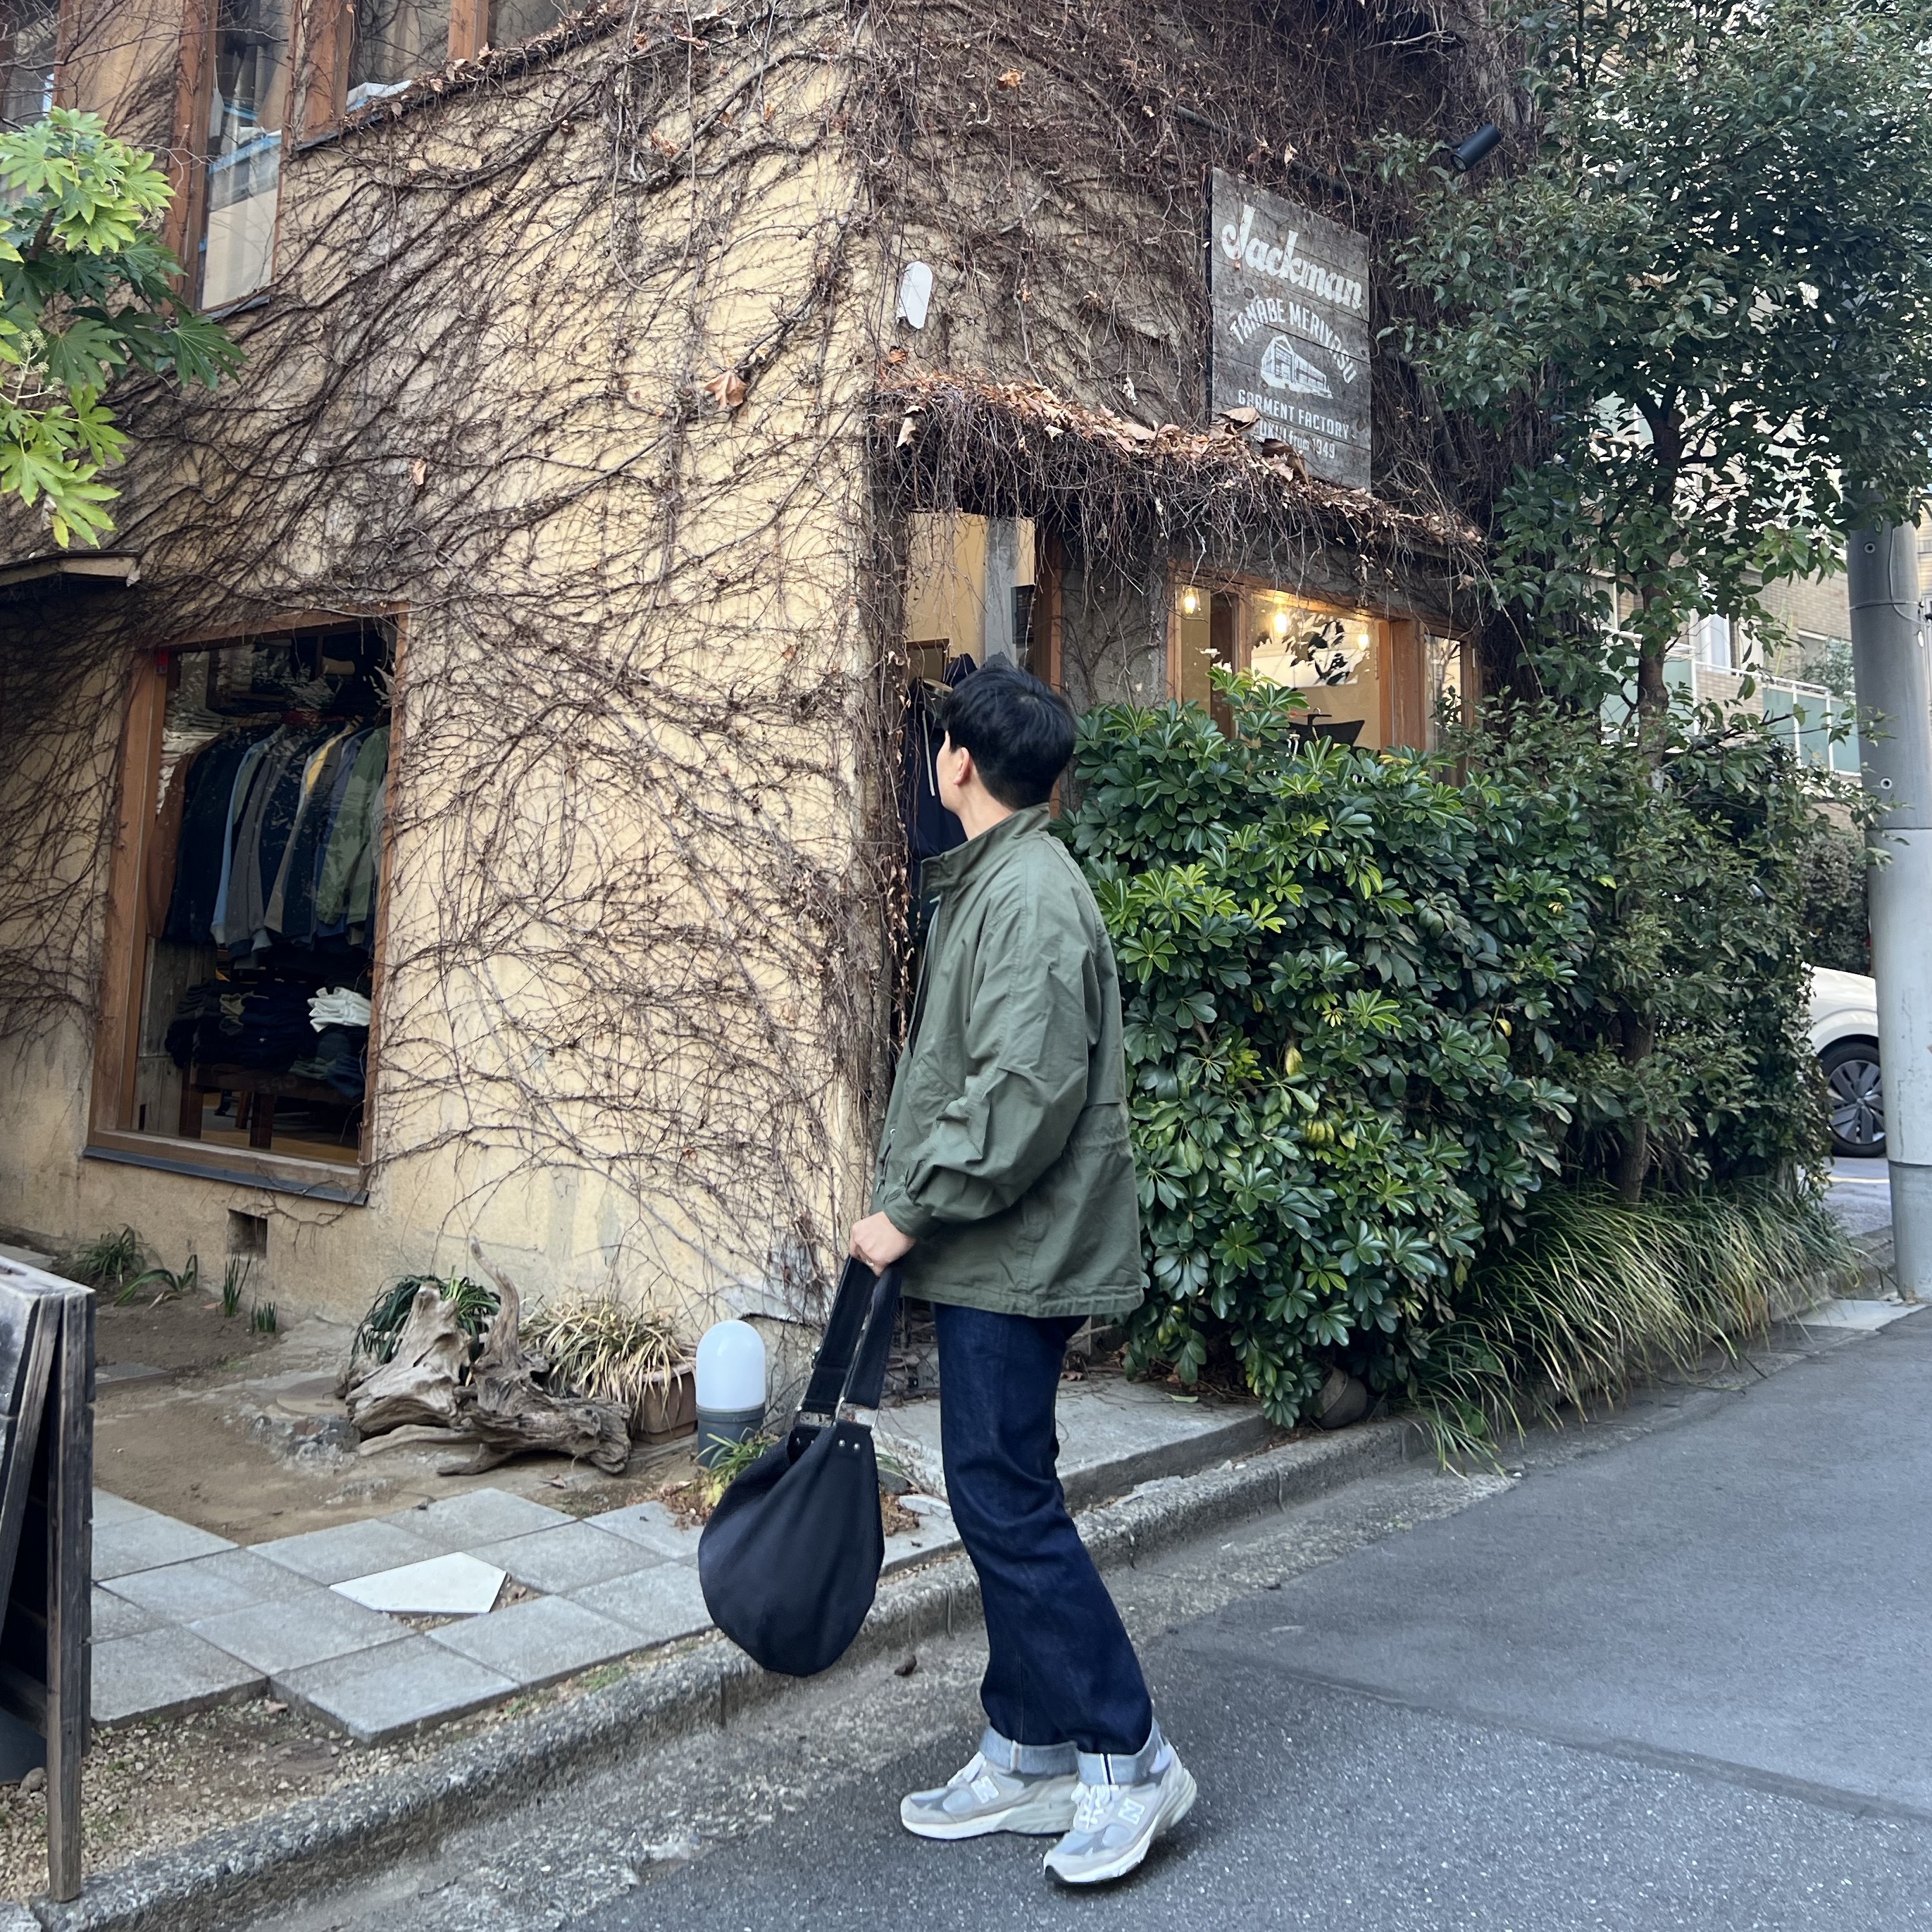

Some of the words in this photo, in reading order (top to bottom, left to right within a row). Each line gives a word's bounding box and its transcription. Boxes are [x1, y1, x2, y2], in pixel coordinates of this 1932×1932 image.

[1221, 204, 1362, 310] Jackman
[1230, 298, 1285, 345] TANABE
[1289, 301, 1357, 384] MERIYASU
[1238, 389, 1295, 423] GARMENT
[1298, 409, 1350, 440] FACTORY
[1289, 430, 1310, 451] from
[1311, 437, 1335, 459] 1949
[971, 1775, 999, 1804] N
[1118, 1797, 1145, 1826] N
